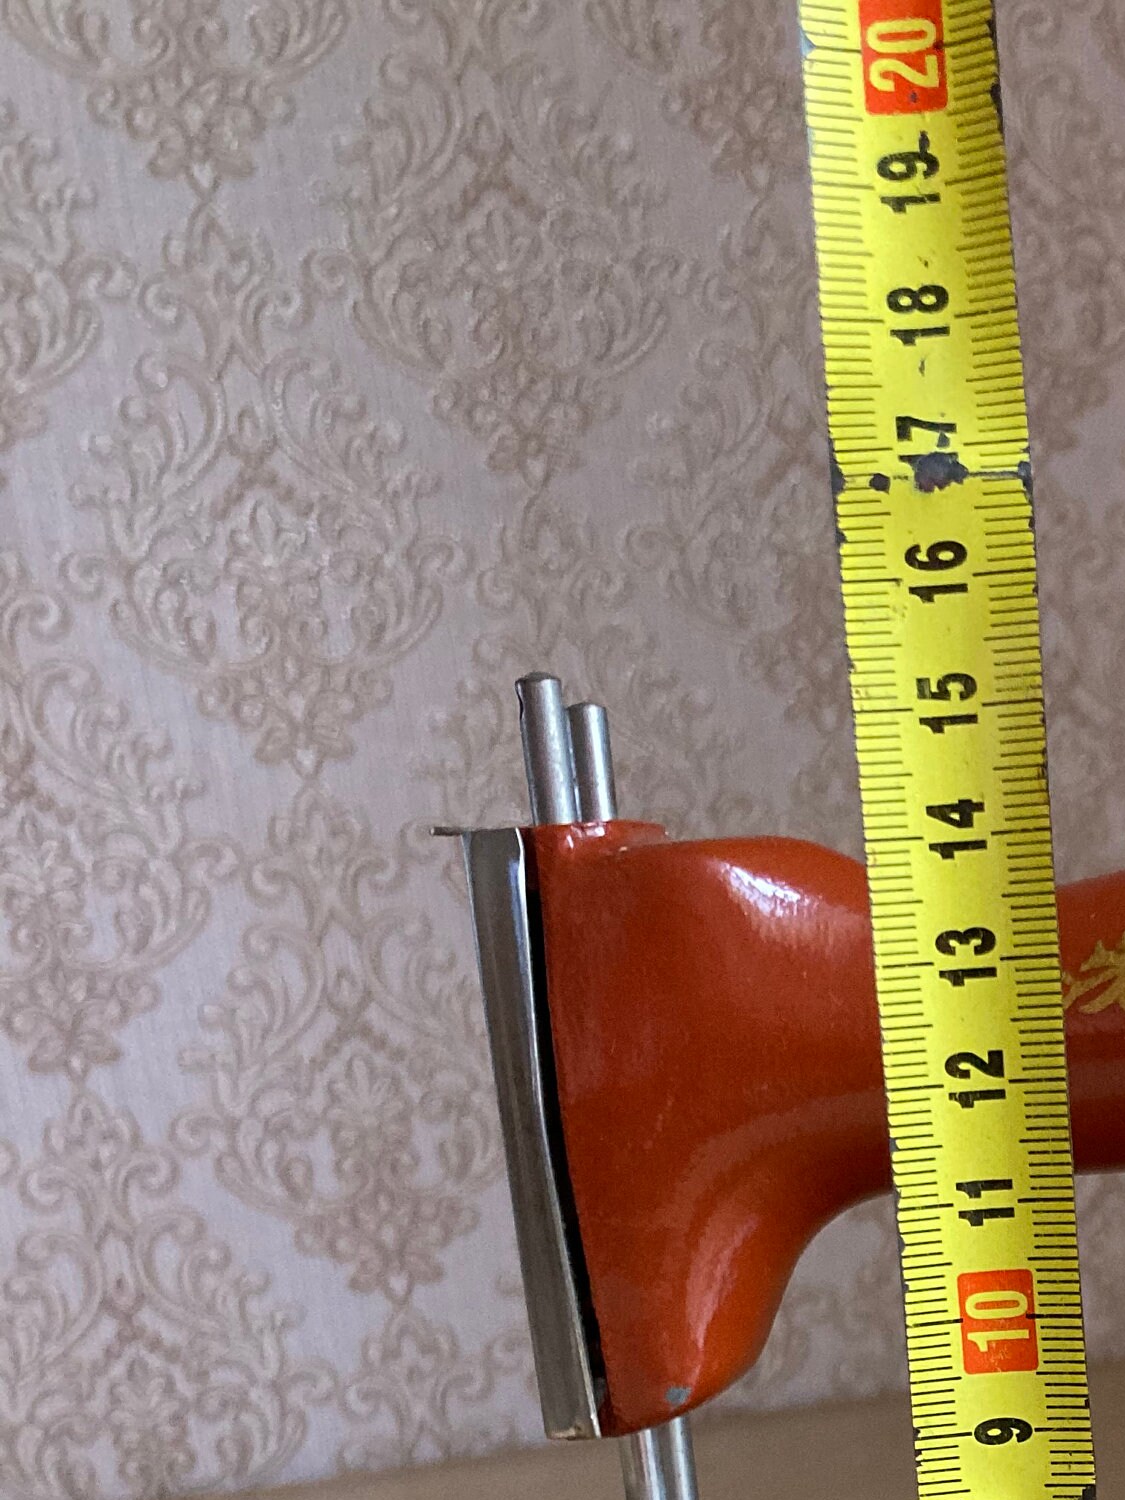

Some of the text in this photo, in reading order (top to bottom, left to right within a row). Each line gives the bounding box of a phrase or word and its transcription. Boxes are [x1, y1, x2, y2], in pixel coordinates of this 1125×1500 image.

[866, 17, 939, 92] 20
[877, 148, 941, 214] 19
[887, 284, 951, 346] 18
[905, 540, 968, 602] 16
[916, 673, 978, 733] 15
[926, 799, 987, 860] 14
[935, 926, 997, 987] 13
[945, 1049, 1006, 1108] 12
[956, 1178, 1015, 1227] 11
[964, 1290, 1030, 1354] 10
[974, 1417, 1033, 1446] 9
